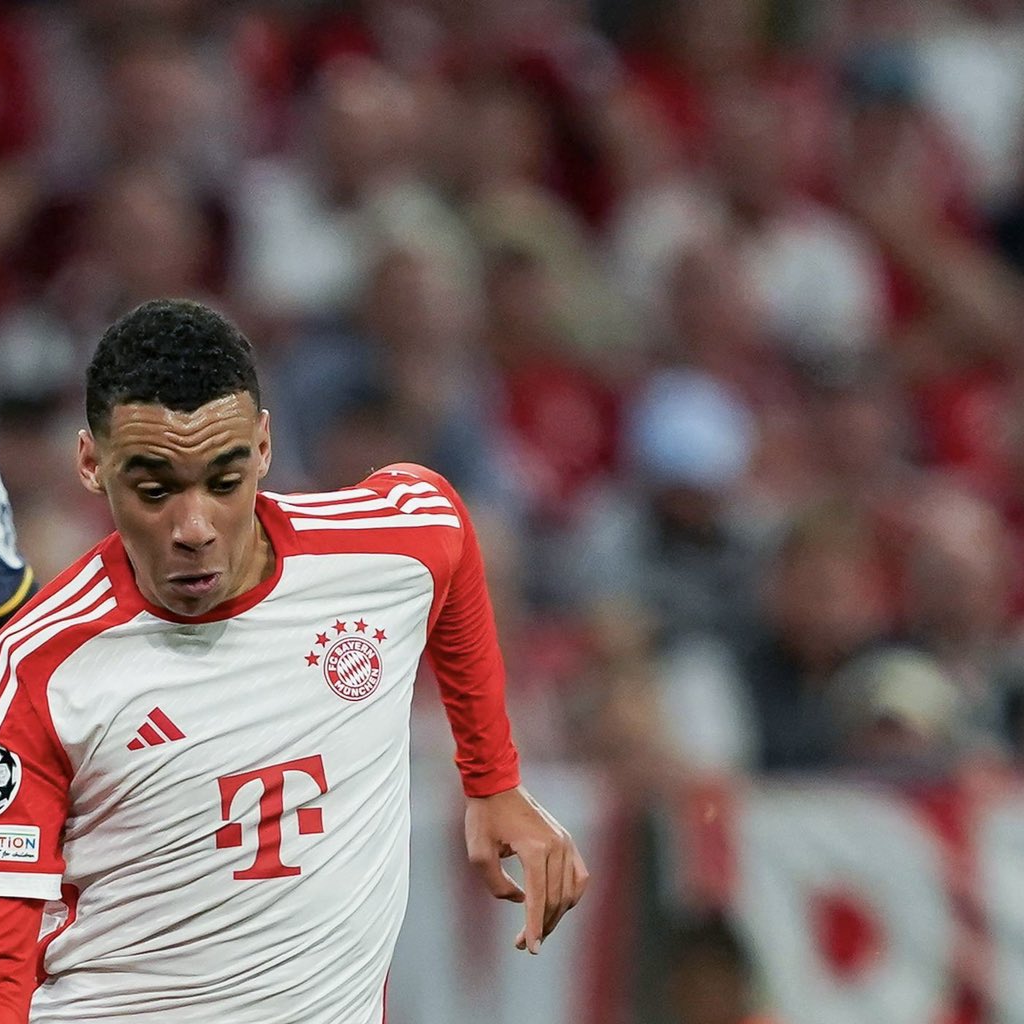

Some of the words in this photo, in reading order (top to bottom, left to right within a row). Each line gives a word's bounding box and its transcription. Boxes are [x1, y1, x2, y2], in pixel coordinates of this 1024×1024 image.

[328, 656, 338, 671] FC
[335, 641, 375, 659] BAYERN
[215, 753, 328, 880] T
